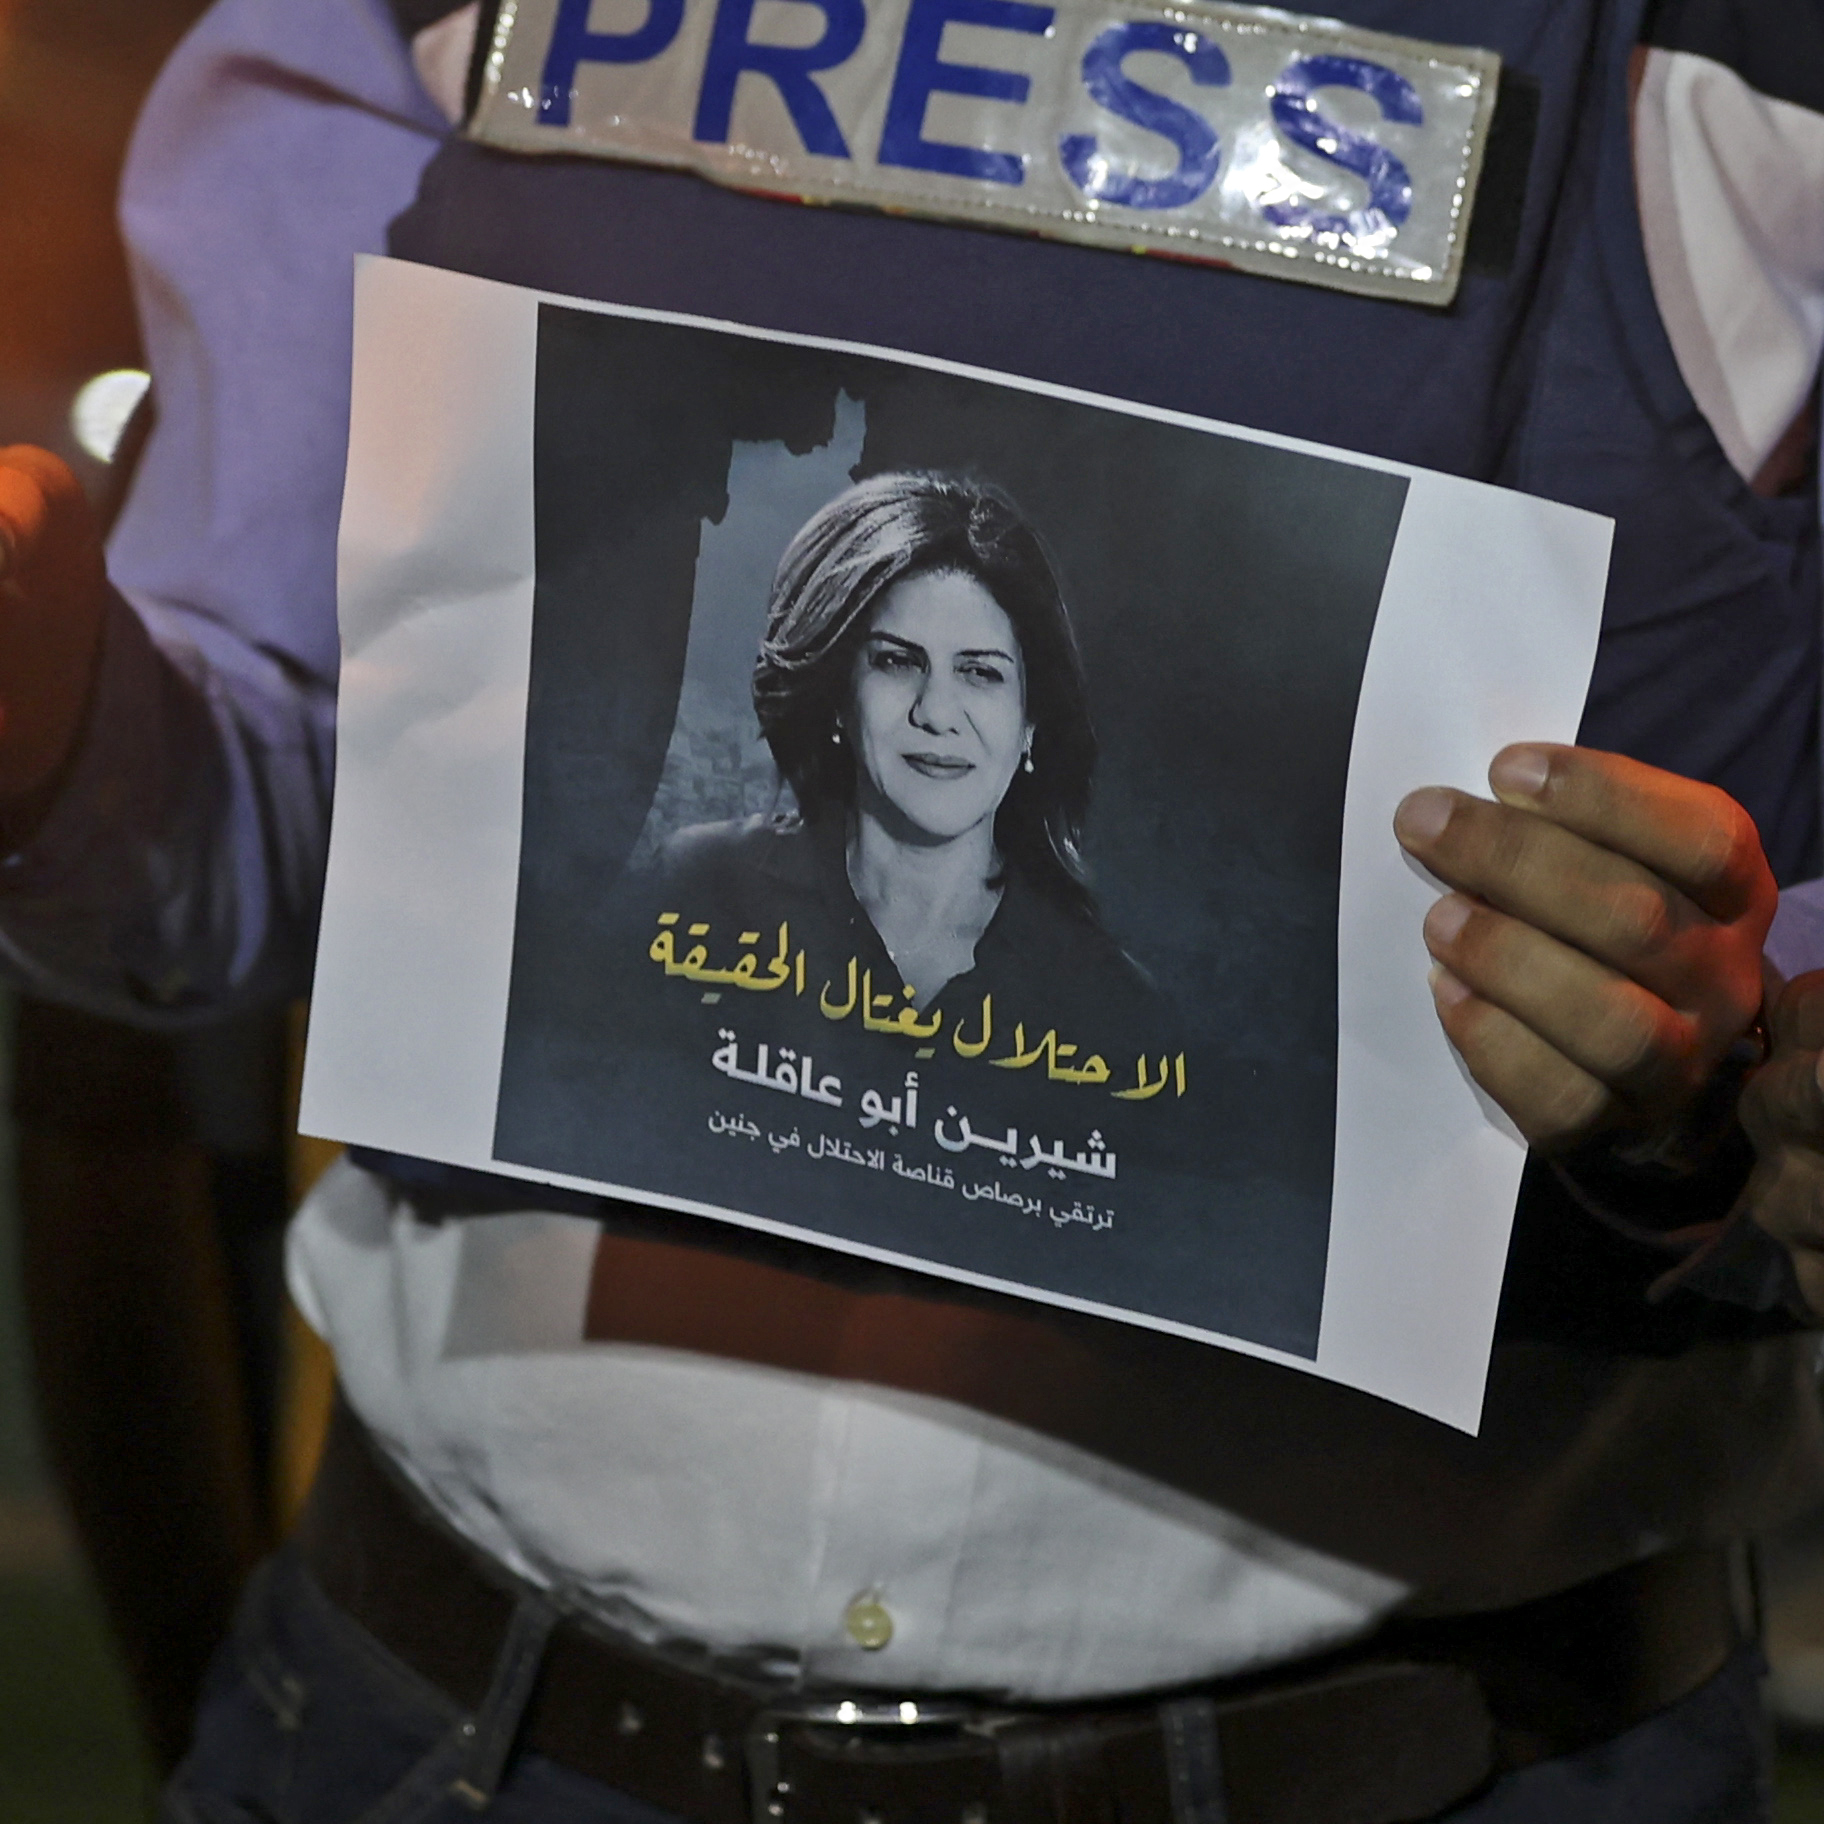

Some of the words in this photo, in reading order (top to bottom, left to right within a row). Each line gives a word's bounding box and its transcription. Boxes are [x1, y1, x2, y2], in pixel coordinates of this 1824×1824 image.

[649, 912, 806, 1005] الحقيقة
[820, 956, 942, 1059] يغتال
[711, 1027, 843, 1108] عاقلة
[953, 993, 1186, 1100] الاحتلال
[708, 1110, 761, 1141] جنين
[859, 1071, 919, 1136] أبو
[768, 1127, 801, 1154] في
[807, 1133, 885, 1171] الاحتلال
[934, 1105, 1117, 1180] شيرين
[891, 1152, 955, 1190] قناصة
[961, 1181, 1042, 1218] برصاص
[1049, 1200, 1115, 1231] ترتقي
